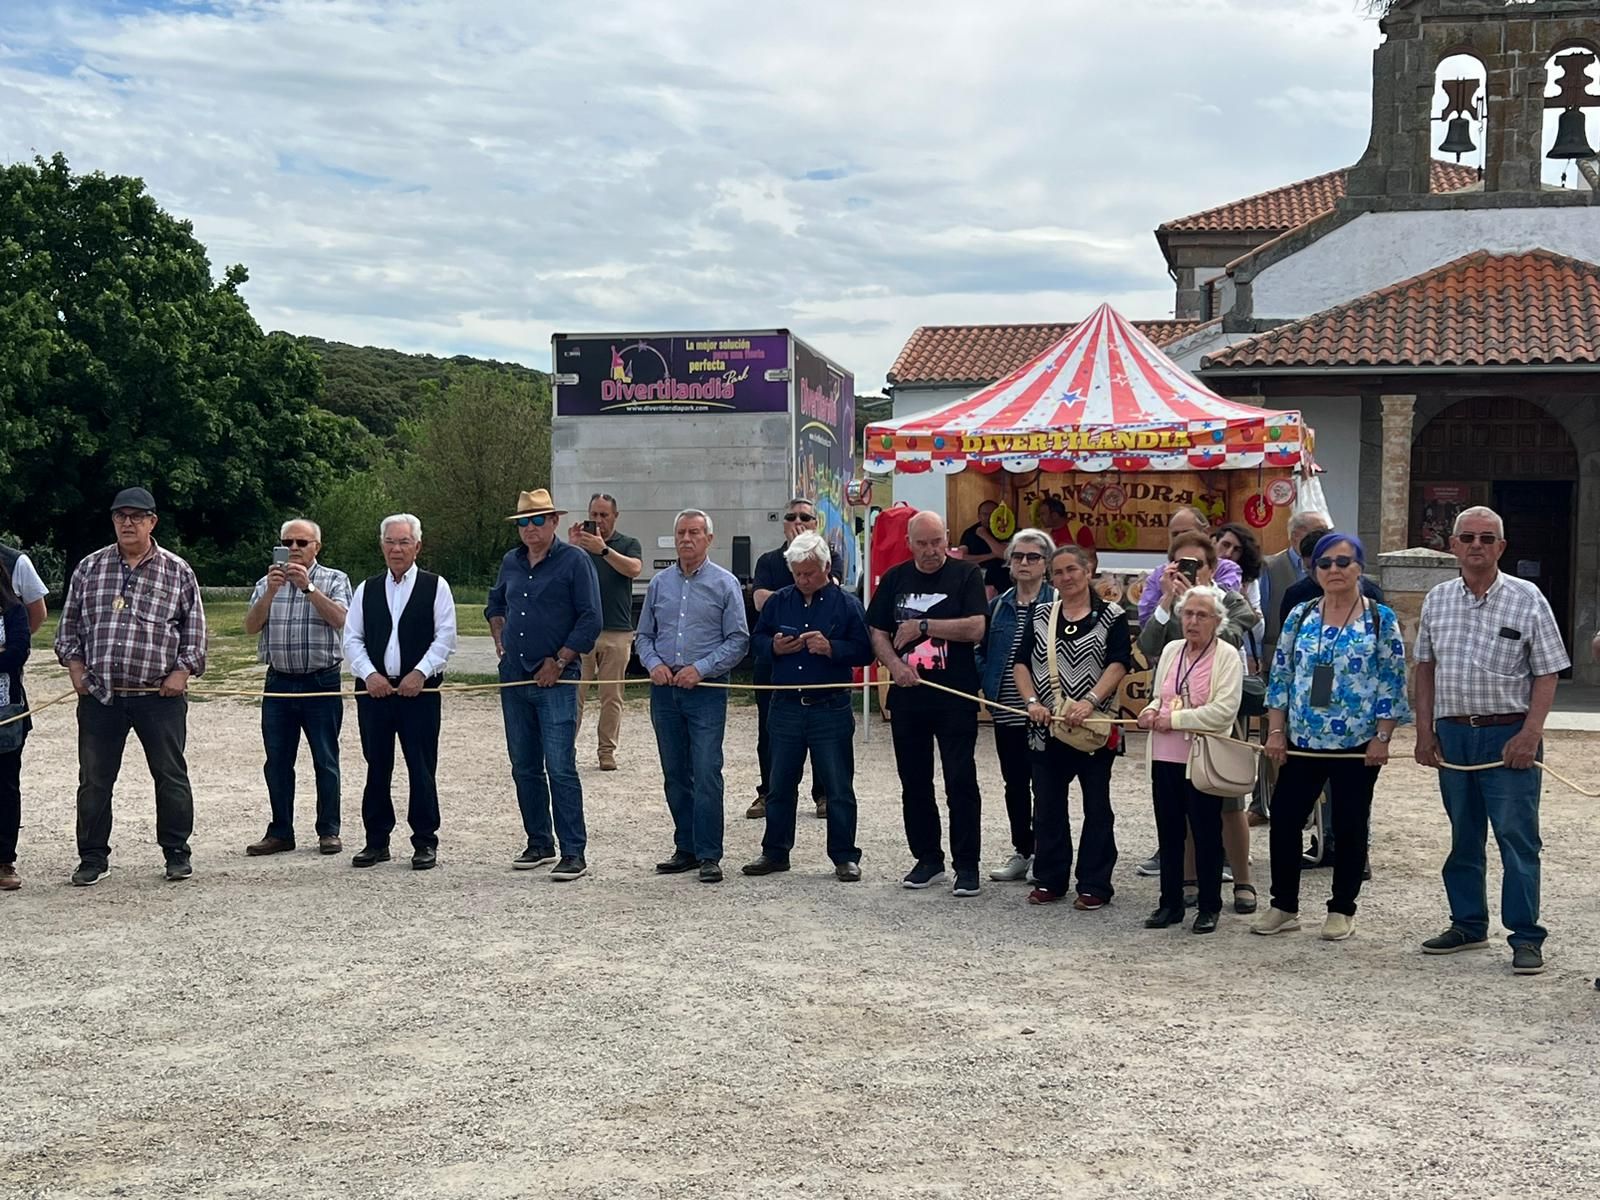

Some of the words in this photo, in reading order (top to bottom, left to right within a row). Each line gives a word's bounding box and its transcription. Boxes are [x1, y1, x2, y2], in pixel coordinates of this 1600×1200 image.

[685, 339, 695, 351] La
[695, 340, 718, 353] mejor
[719, 338, 751, 351] solución
[689, 358, 726, 374] perfecta
[601, 377, 735, 401] Divertilandia
[961, 431, 1191, 453] DIVERTILANDIA
